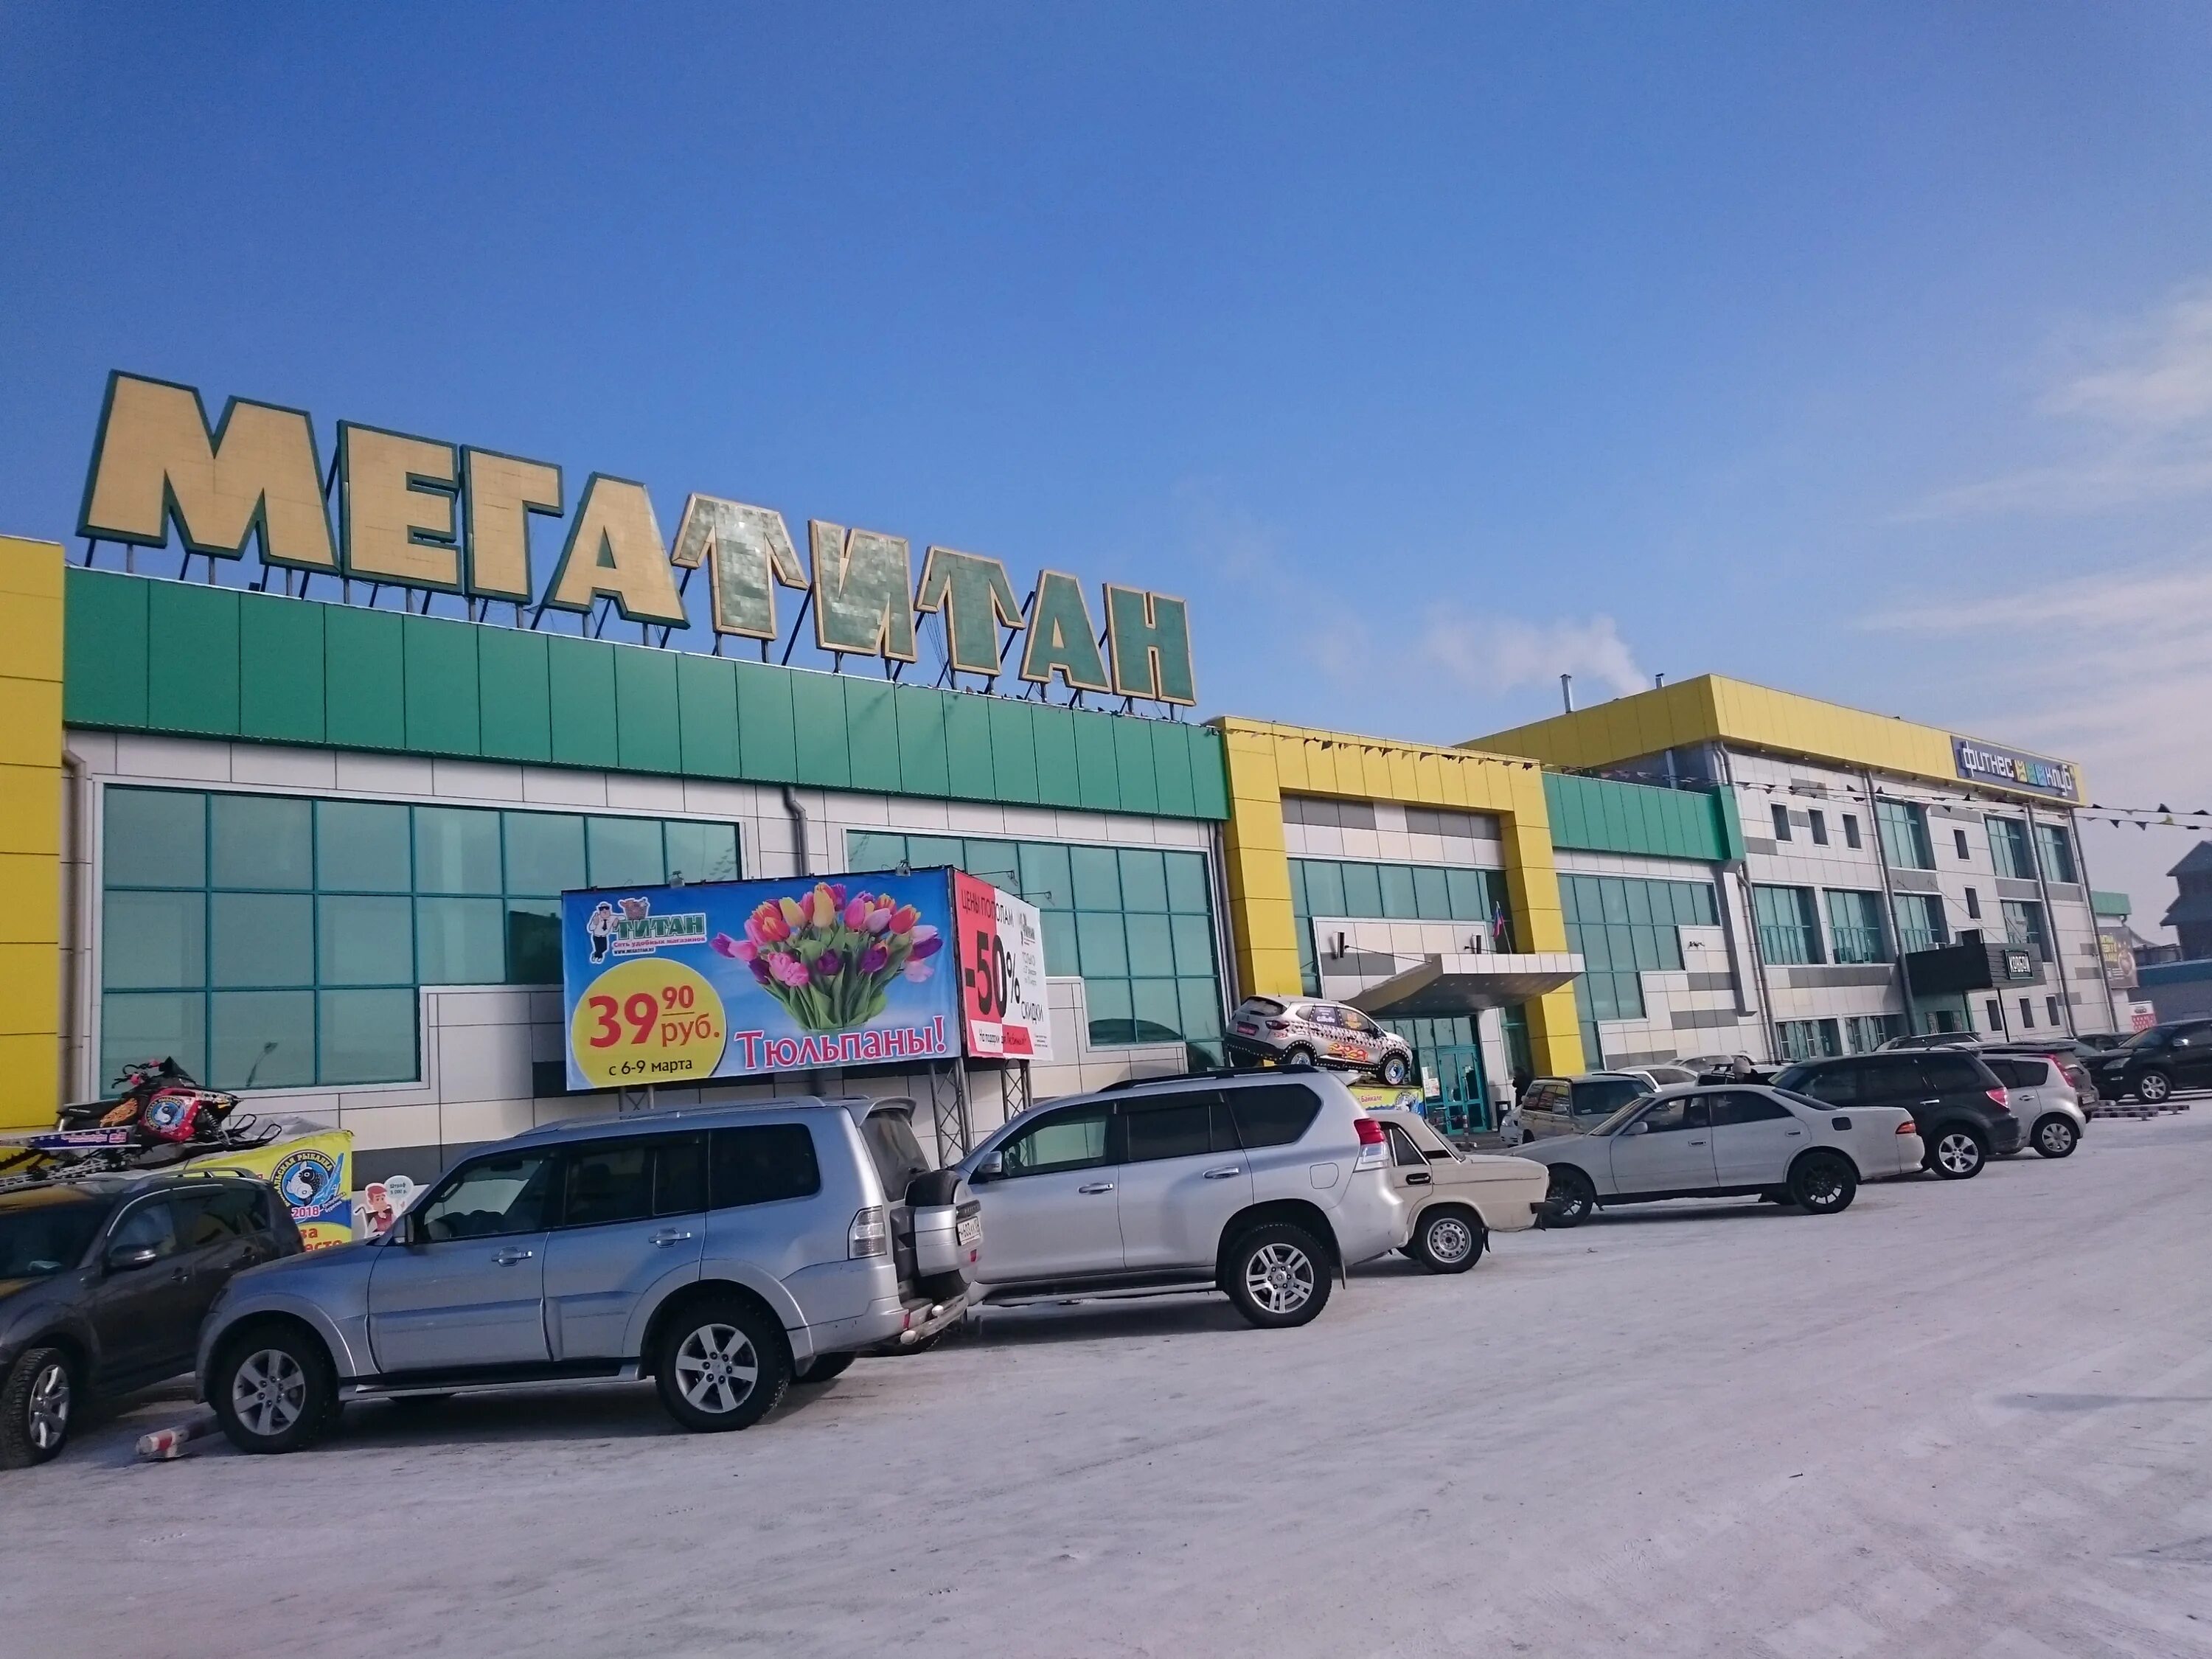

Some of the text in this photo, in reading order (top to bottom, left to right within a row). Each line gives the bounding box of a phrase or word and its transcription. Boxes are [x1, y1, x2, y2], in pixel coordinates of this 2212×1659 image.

[1959, 740, 2073, 796] фитнес клуб
[961, 889, 1014, 928] ЦЕНЫ ПОПОЛАМ
[613, 914, 706, 941] ТИТАН
[631, 939, 666, 948] удобных
[667, 936, 706, 945] магазинов
[964, 930, 1020, 1018] -50%
[588, 985, 694, 1048] 39 90
[661, 1013, 720, 1047] руб.
[734, 1015, 947, 1069] Тюльпаны!
[609, 1060, 692, 1076] с 6-9 марта
[296, 1152, 333, 1172] РЫБАЛКА
[291, 1205, 320, 1219] 2018
